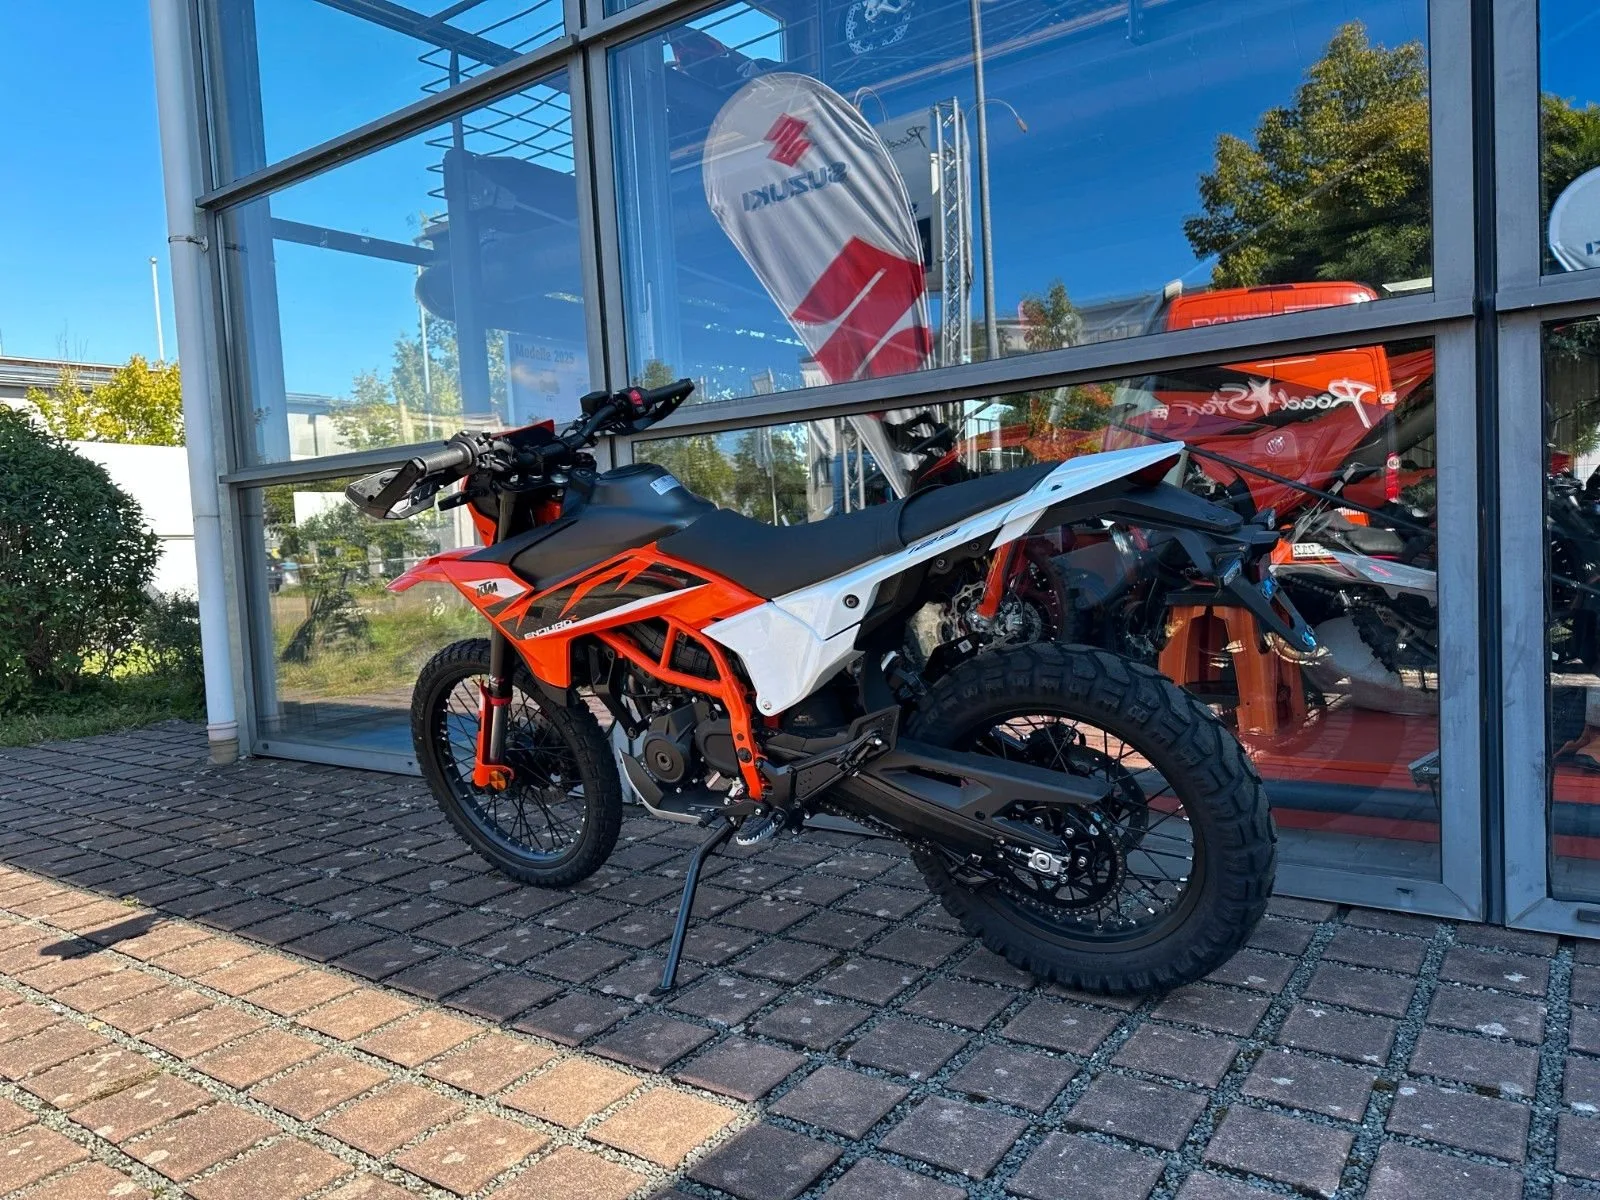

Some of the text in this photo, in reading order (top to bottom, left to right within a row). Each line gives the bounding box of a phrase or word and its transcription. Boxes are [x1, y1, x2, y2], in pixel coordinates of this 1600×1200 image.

[514, 343, 576, 365] Modelle 2025
[477, 581, 498, 598] KTM
[524, 619, 572, 640] ENDURO
